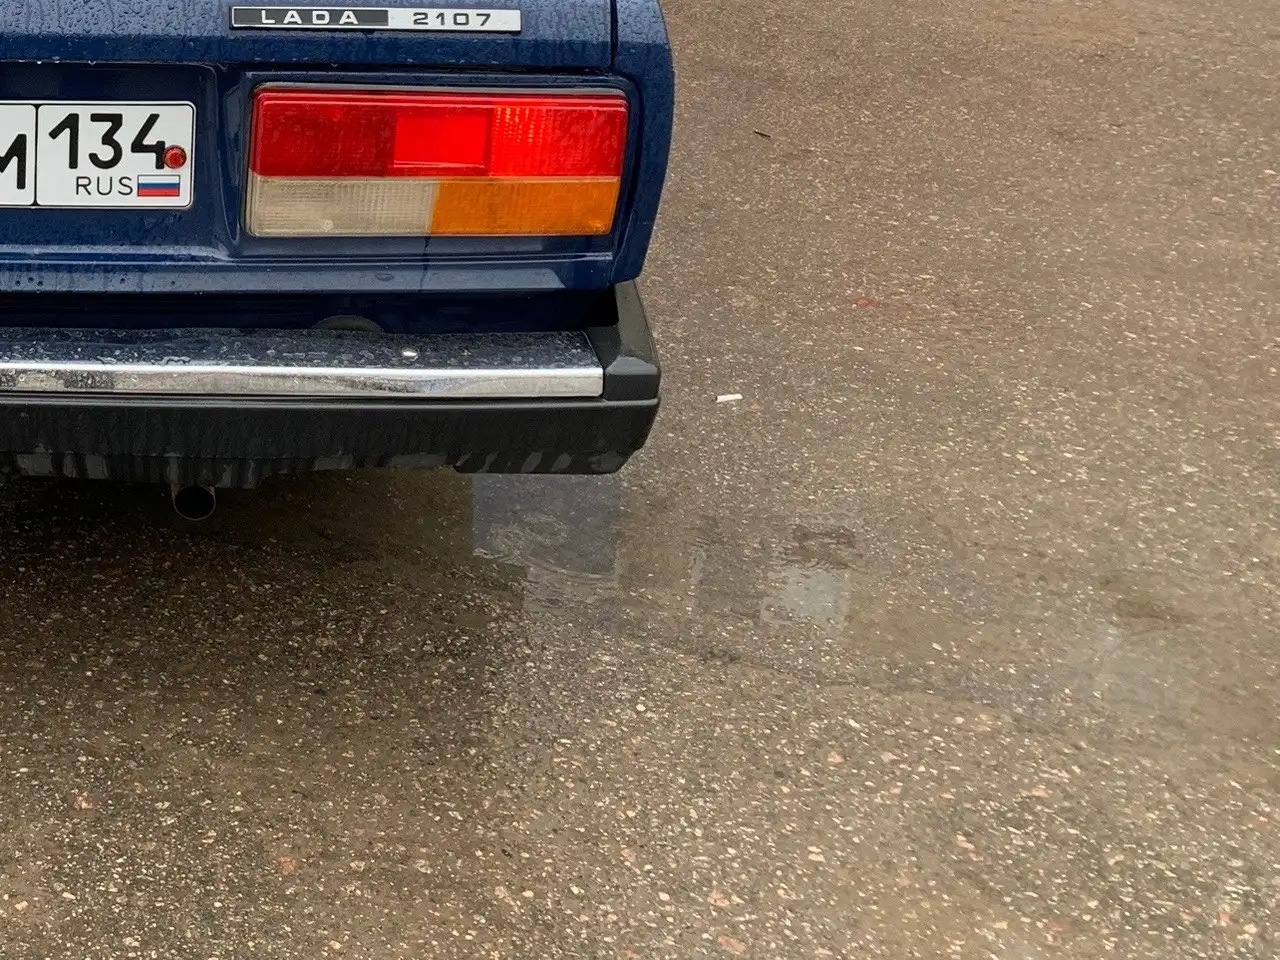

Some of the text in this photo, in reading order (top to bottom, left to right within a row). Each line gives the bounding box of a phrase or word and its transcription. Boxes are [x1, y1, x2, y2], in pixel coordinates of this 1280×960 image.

[260, 9, 492, 27] LADA 2107
[48, 113, 167, 170] 134
[74, 175, 134, 197] RUS
